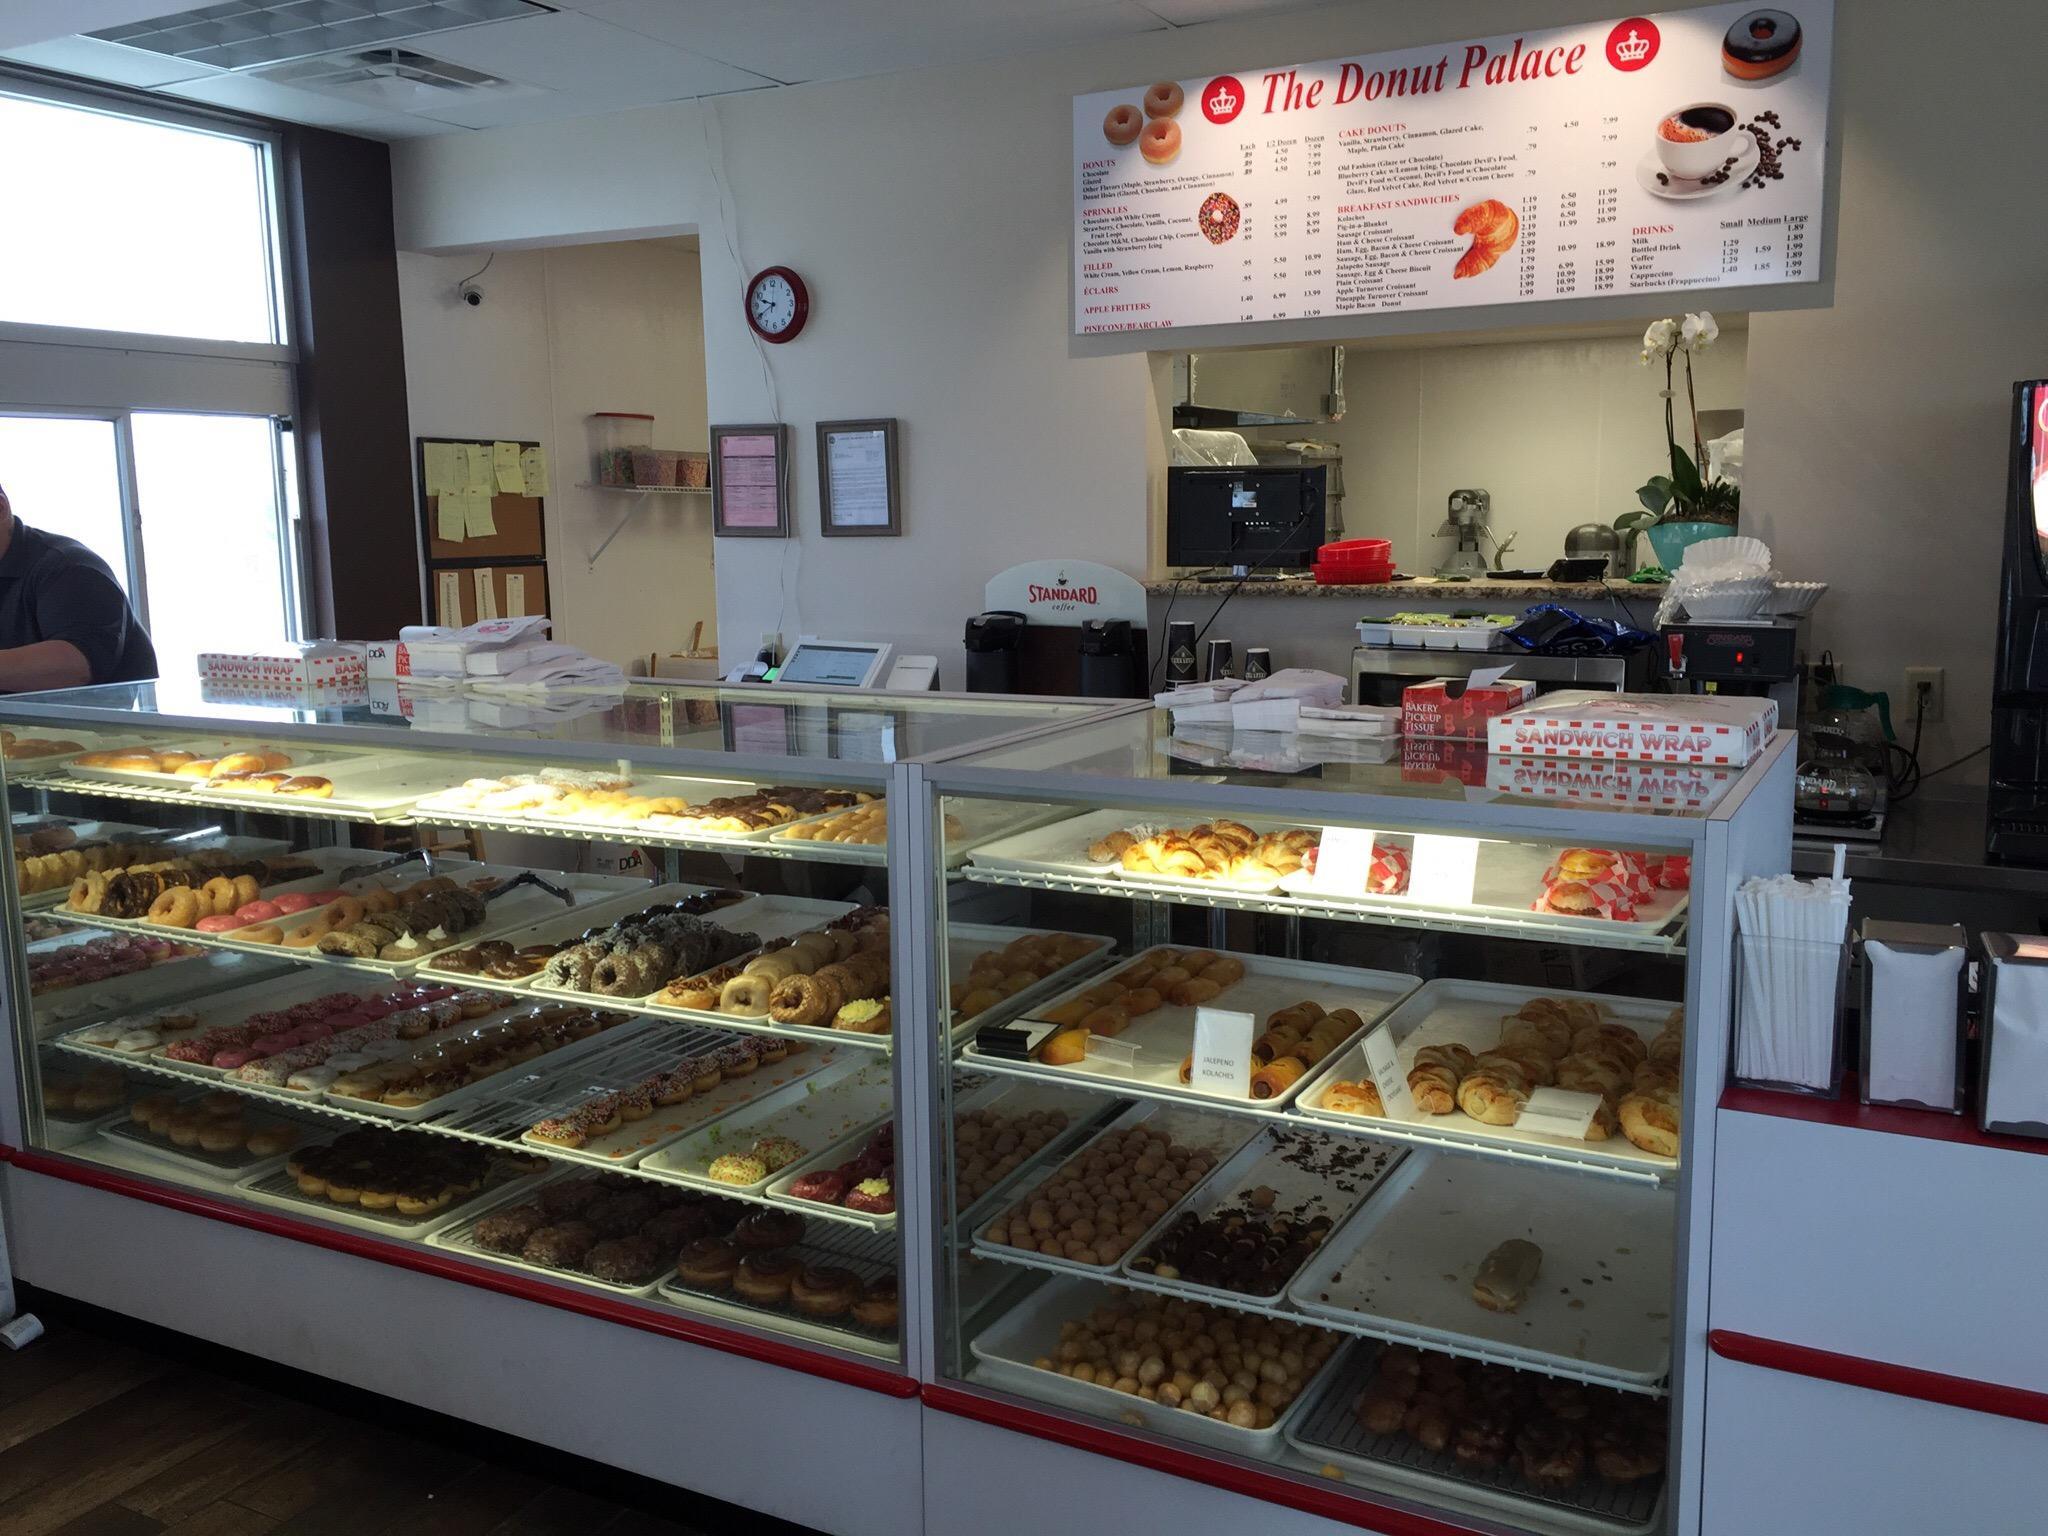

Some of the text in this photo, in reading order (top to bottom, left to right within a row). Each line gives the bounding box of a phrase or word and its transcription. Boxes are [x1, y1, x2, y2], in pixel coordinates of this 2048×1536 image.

[1262, 38, 1586, 114] The Donut Palace
[1338, 123, 1406, 138] CAKE DONUTS
[1304, 134, 1324, 142] Dozen
[1240, 142, 1255, 150] Each
[1347, 141, 1404, 154] Maple, Plain Cake
[1082, 159, 1115, 169] DONUTS
[1337, 154, 1443, 172] Old Fashion (Glaze or Chocolate)
[1082, 169, 1109, 178] Chocolate
[1082, 177, 1101, 185] Glazed
[1346, 171, 1514, 195] Glaze, Red Velvet Cake, Red Velvet w/Cream Cheese
[1560, 191, 1576, 199] 6.50
[1598, 187, 1617, 195] 11.99
[1522, 195, 1537, 203] 1.19
[1337, 194, 1459, 214] BREAKFAST SANDWICHES
[1083, 205, 1127, 217] SPRINKLES
[1337, 214, 1365, 222] Kolaches
[1596, 215, 1616, 223] 20.99
[1747, 215, 1781, 226] Medium
[1783, 212, 1808, 223] Large
[1337, 219, 1387, 231] Pig-in-a-Blanket
[1521, 222, 1536, 230] 2.19
[1559, 219, 1577, 227] 11.99
[1720, 219, 1743, 228] Small
[1787, 222, 1804, 231] 1.89
[1336, 227, 1392, 239] Sausage Croissant
[1632, 223, 1673, 235] DRINKS
[1336, 238, 1351, 246] Ham
[1361, 236, 1382, 244] Cheese
[1384, 233, 1414, 242] Croissant
[1631, 237, 1648, 245] Milk
[1787, 232, 1803, 241] 1.89
[1336, 238, 1453, 255] Ham, Egg, Bacon & Cheese Croissant
[1557, 243, 1576, 251] 10.99
[1596, 239, 1615, 248] 18.99
[1723, 238, 1739, 247] 1.29
[1786, 242, 1803, 250] 1.99
[1520, 246, 1535, 255] 1.99
[1631, 243, 1680, 254] Bottled Drink
[1722, 247, 1738, 256] 1.29
[1755, 244, 1771, 253] 1.59
[1336, 245, 1463, 263] Sausage, Egg, Bacon & Cheese Croissant
[1630, 253, 1654, 262] Coffee
[1786, 250, 1802, 259] 1.89
[1722, 256, 1738, 264] 1.29
[1785, 259, 1802, 268] 1.99
[1083, 261, 1112, 271] FILLED
[1630, 262, 1652, 271] Water
[1721, 265, 1737, 273] 1.40
[1754, 262, 1770, 271] 1.85
[1335, 264, 1431, 279] Sausage, Egg & Cheese Biscuit
[1630, 270, 1673, 280] Cappuccino
[1785, 268, 1801, 277] 1.99
[1353, 277, 1383, 285] Croissant
[1556, 277, 1575, 285] 10.99
[1594, 274, 1614, 282] 18.99
[1629, 275, 1720, 288] Starbucks (Frappuccino)
[1335, 282, 1415, 295] Apple Turnover Croissant
[1519, 280, 1534, 288] 1.99
[1594, 282, 1613, 290] 18.99
[1083, 283, 1118, 295] ÉCLAIRS
[1519, 288, 1533, 296] 1.99
[1556, 285, 1575, 293] 10.99
[1335, 289, 1428, 303] Pineapple Turnover Croissant
[1084, 302, 1150, 314] APPLE FRITTERS
[1335, 299, 1401, 311] Maple Bacon Donut
[1029, 585, 1097, 604] STANDARD
[208, 662, 294, 676] SANDWICH WRAP
[1405, 702, 1439, 713] BAKERY
[1405, 712, 1441, 722] PICK-UP
[1404, 722, 1435, 732] TISSUE
[1515, 727, 1712, 753] SANDWICH WRAP
[1202, 1069, 1234, 1080] KOLACHES
